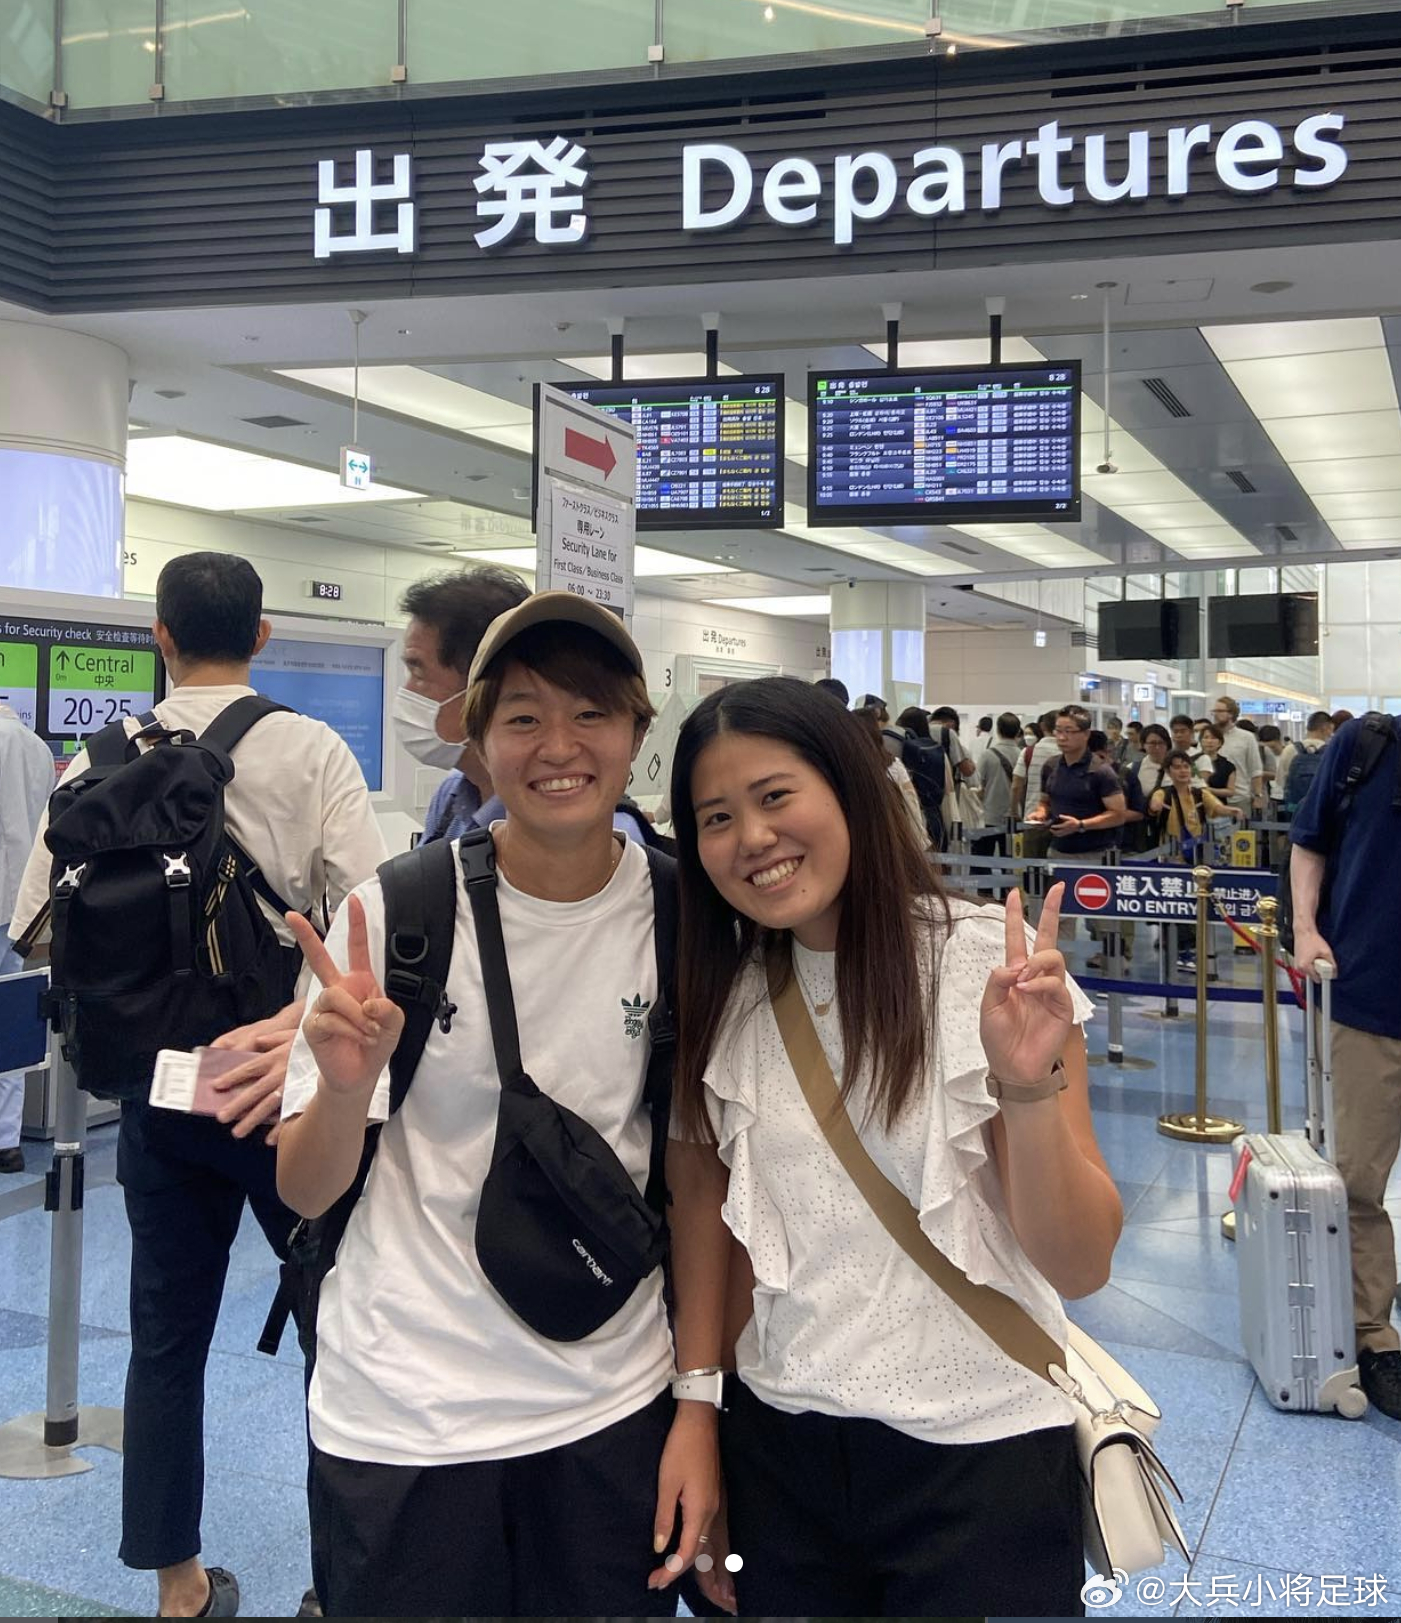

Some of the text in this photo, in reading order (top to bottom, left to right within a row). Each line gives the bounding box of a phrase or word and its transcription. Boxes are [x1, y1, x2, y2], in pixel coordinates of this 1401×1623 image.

[682, 112, 1349, 244] Departures
[561, 537, 618, 562] Security Lane for
[554, 558, 567, 572] First
[610, 571, 624, 585] Class
[320, 584, 339, 597] 8:28
[595, 588, 612, 602] 23:30
[4, 623, 92, 641] for Security check
[718, 633, 747, 648] Departures
[74, 652, 134, 674] Central
[94, 674, 115, 687] 中央
[665, 668, 672, 687] 3
[63, 697, 132, 726] 20-25
[1116, 899, 1198, 916] NO ENTRY
